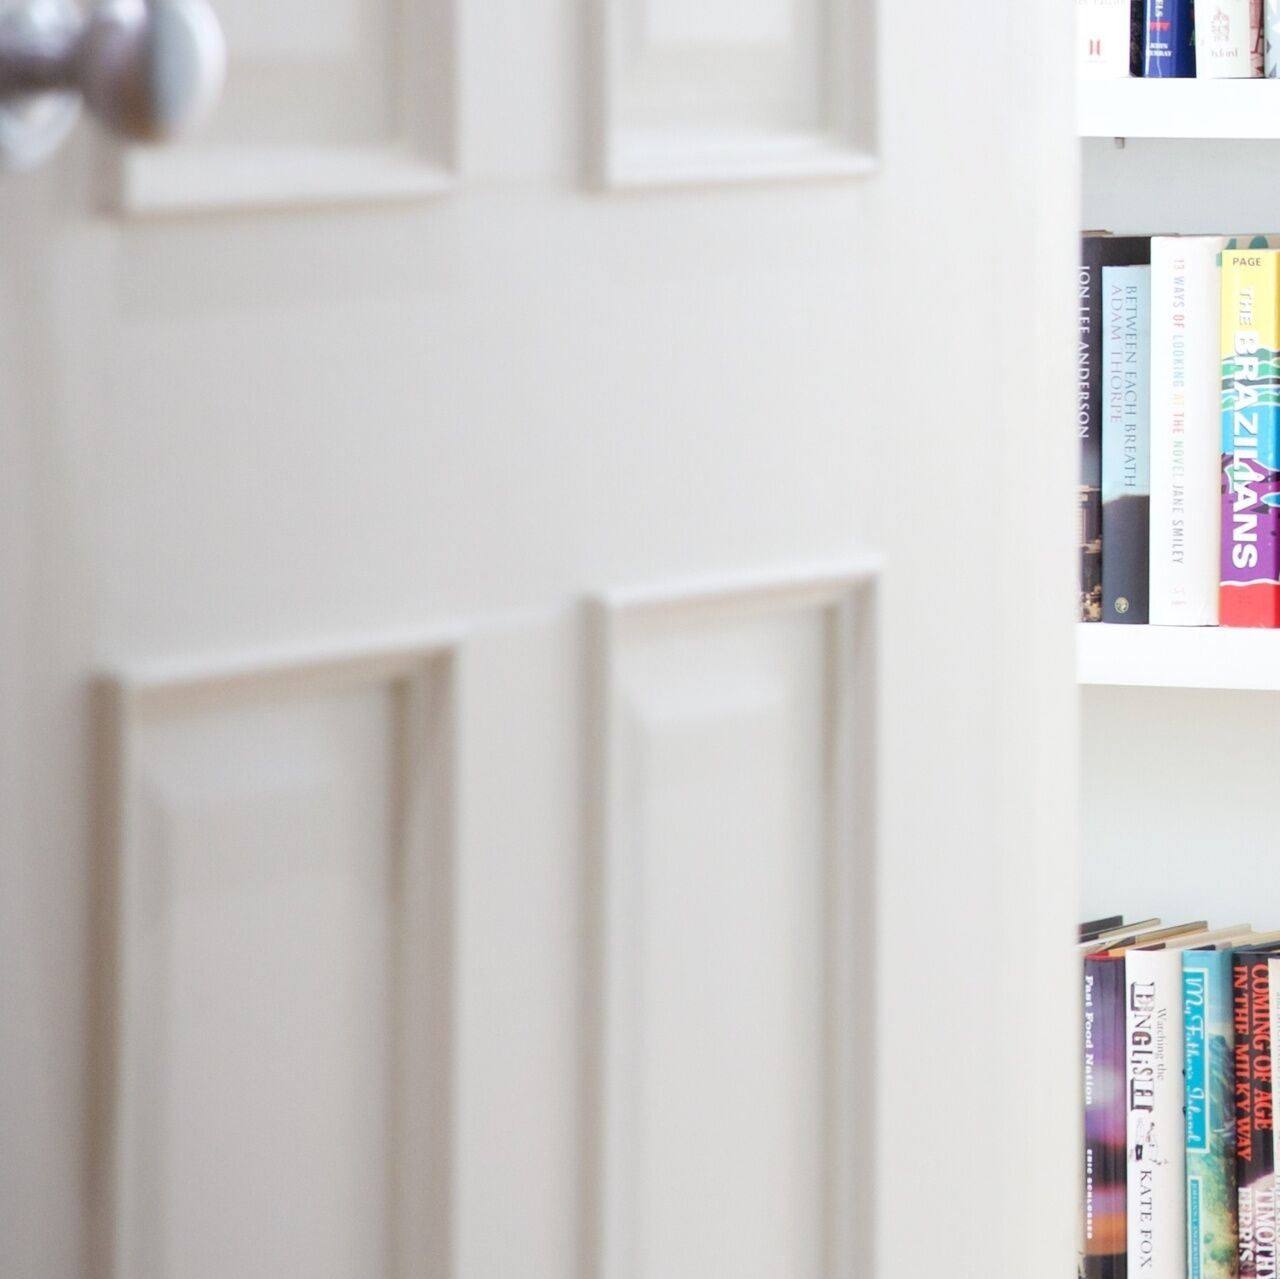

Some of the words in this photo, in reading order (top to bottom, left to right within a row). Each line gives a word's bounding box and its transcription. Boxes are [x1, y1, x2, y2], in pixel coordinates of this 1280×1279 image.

[1124, 286, 1137, 363] BETWEEN
[1239, 287, 1253, 325] THE
[1124, 371, 1137, 416] EACH
[1124, 424, 1138, 488] BREATH
[1232, 331, 1257, 568] BRAZILIANS
[1251, 964, 1270, 1050] COMING
[1253, 1056, 1271, 1079] OF
[1254, 1090, 1273, 1130] AGE
[1139, 1170, 1152, 1222] KATE
[1140, 1230, 1153, 1268] FOX
